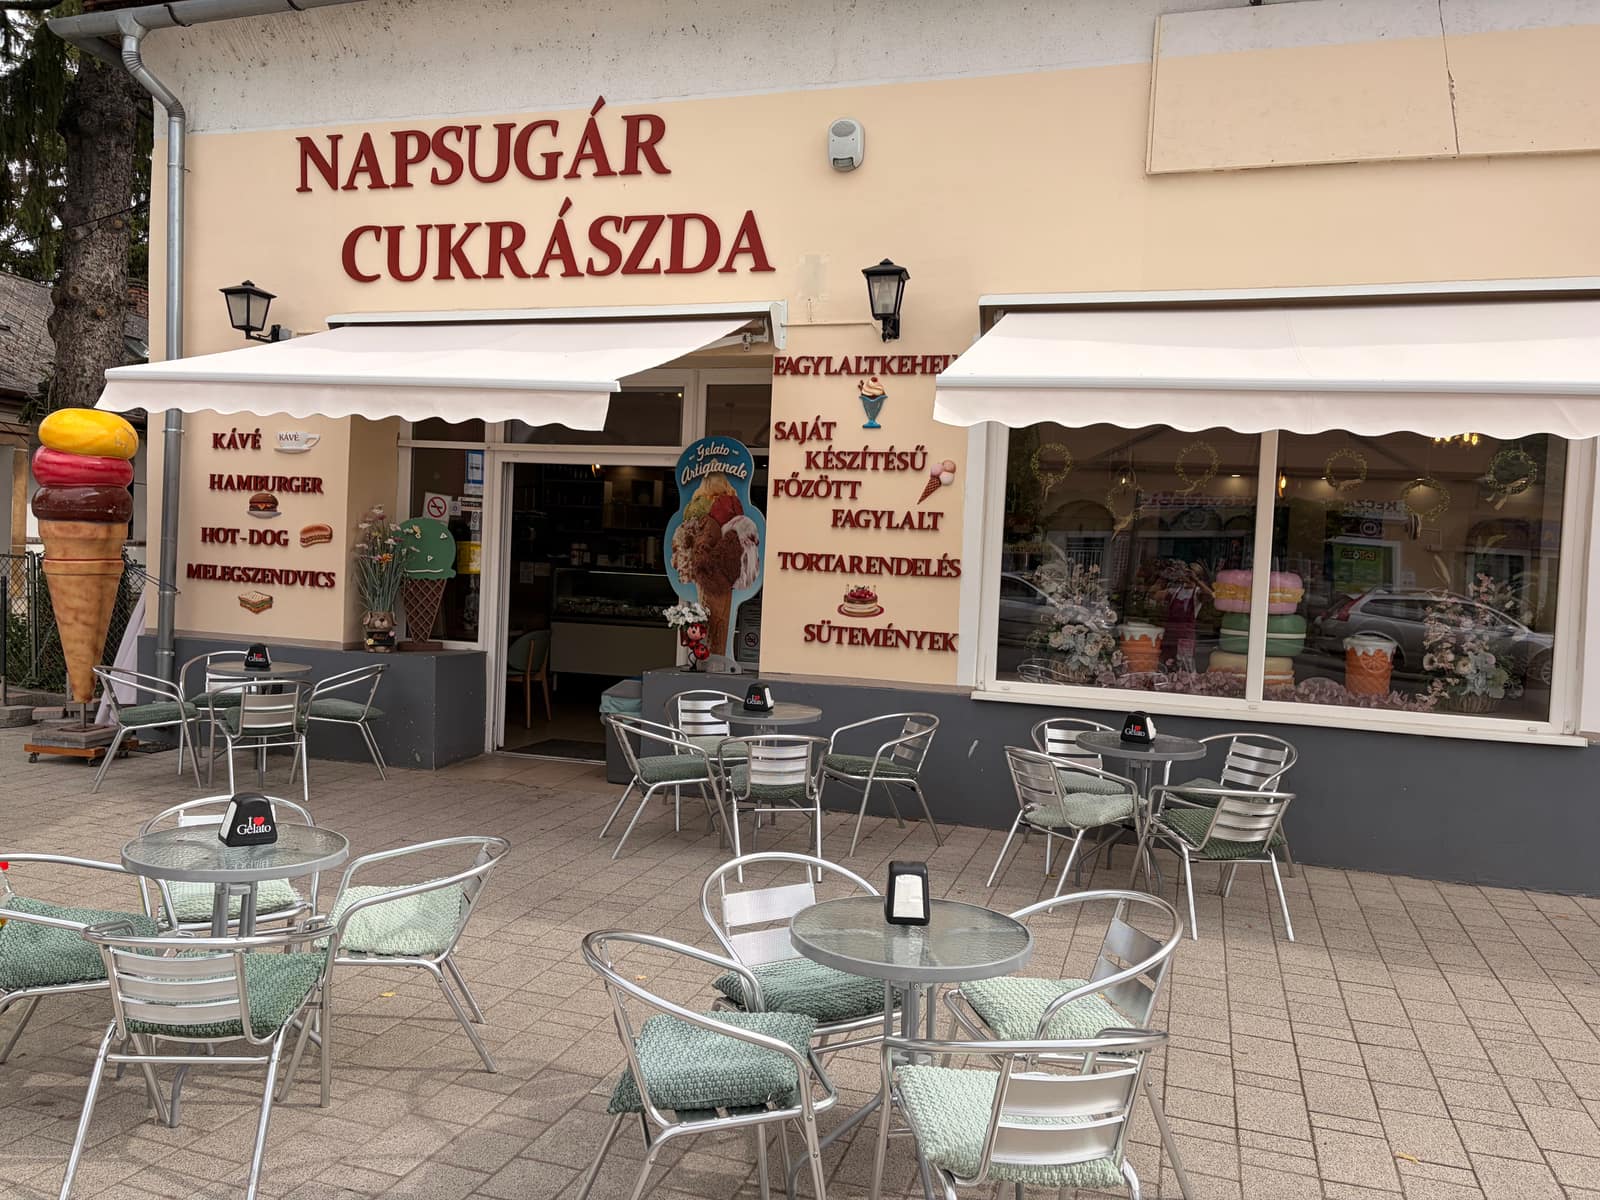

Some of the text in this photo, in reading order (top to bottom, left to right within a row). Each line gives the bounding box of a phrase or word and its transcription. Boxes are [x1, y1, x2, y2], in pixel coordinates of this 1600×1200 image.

[296, 96, 671, 192] NAPSUGÁR
[342, 197, 775, 283] CUKRÁSZDA
[773, 354, 958, 376] FAGYLALTKEHEL
[212, 427, 261, 450] KÁVÉ
[775, 415, 836, 445] SAJÁT
[696, 441, 729, 461] Gelato
[805, 445, 928, 472] KÉSZÍTÉSŰ
[209, 473, 324, 494] HAMBURGER
[681, 462, 747, 485] Artigianale
[773, 472, 861, 500] FŐZÖTT
[832, 509, 944, 531] FAGYLALT
[201, 527, 289, 547] HOT-DOG
[186, 563, 335, 588] MELEGSZENDVICS
[778, 552, 961, 579] TORTARENDELÉS
[804, 620, 958, 652] SÜTEMÉNYEK
[236, 823, 272, 835] Gelato
